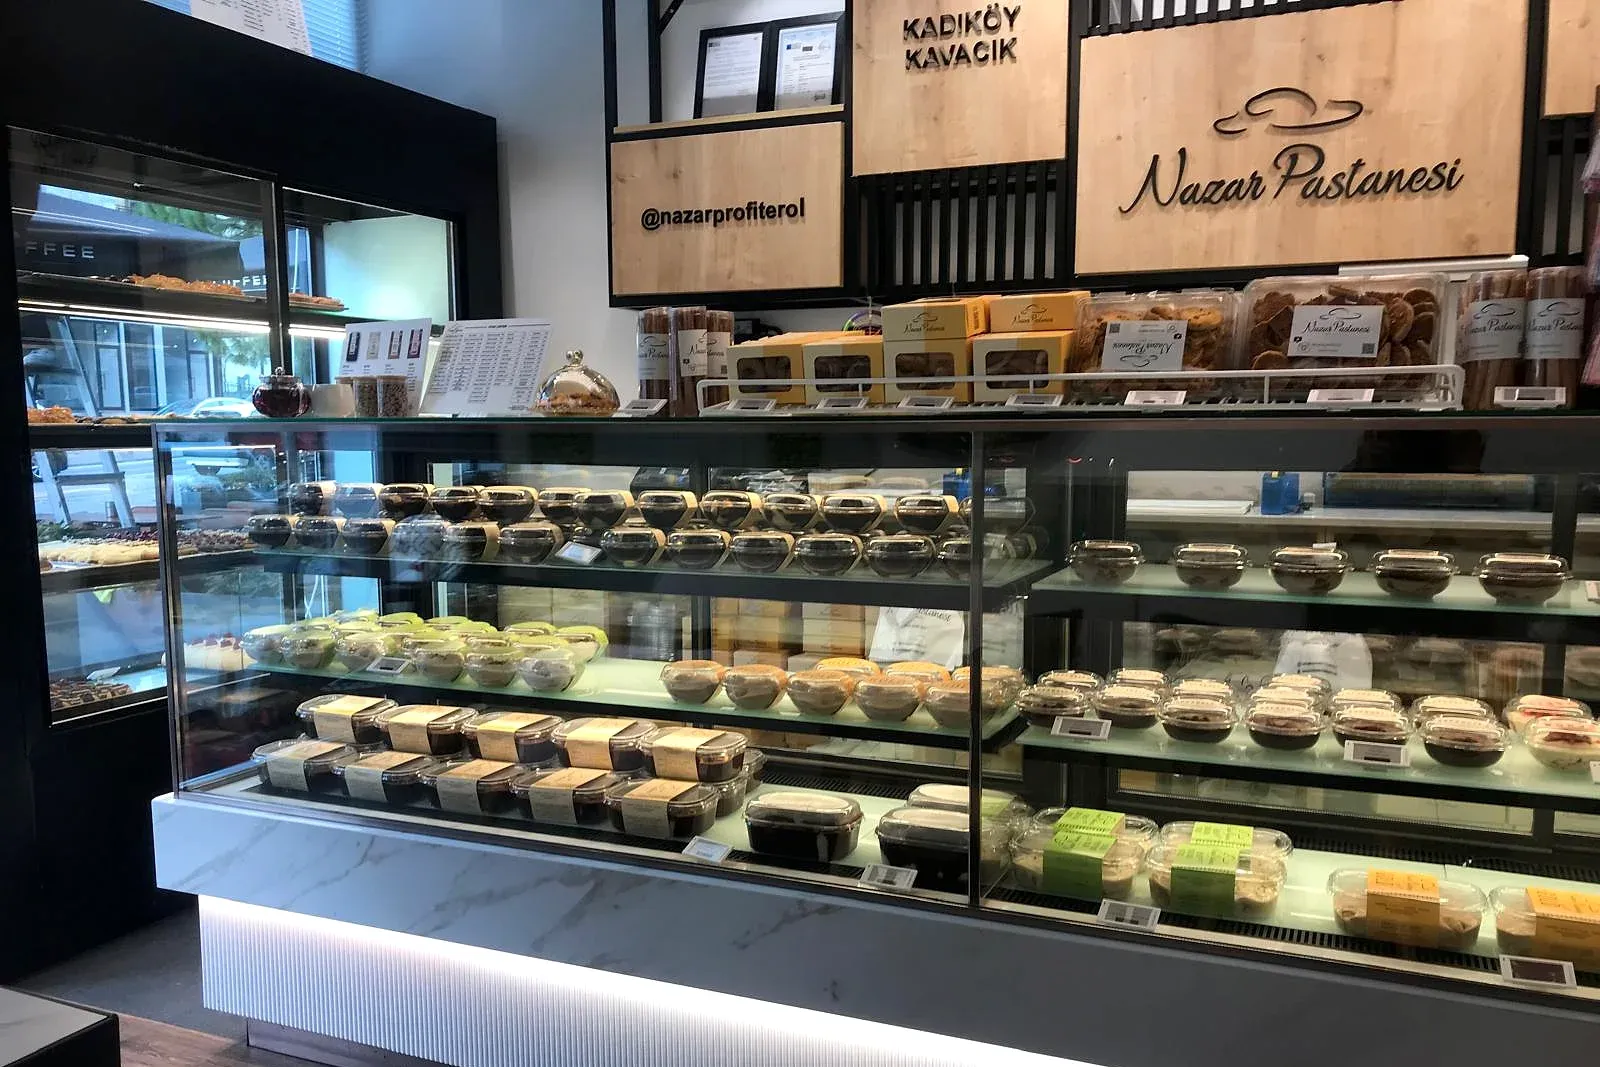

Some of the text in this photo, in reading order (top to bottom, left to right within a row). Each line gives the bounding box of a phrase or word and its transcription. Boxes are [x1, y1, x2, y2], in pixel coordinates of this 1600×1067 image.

[903, 3, 1021, 41] KADIKÖY
[905, 37, 1018, 71] KAVACIK
[1118, 143, 1465, 214] Nazar Pastanesi
[641, 197, 805, 231] @nazarprofiterol
[1302, 320, 1332, 334] Nazar
